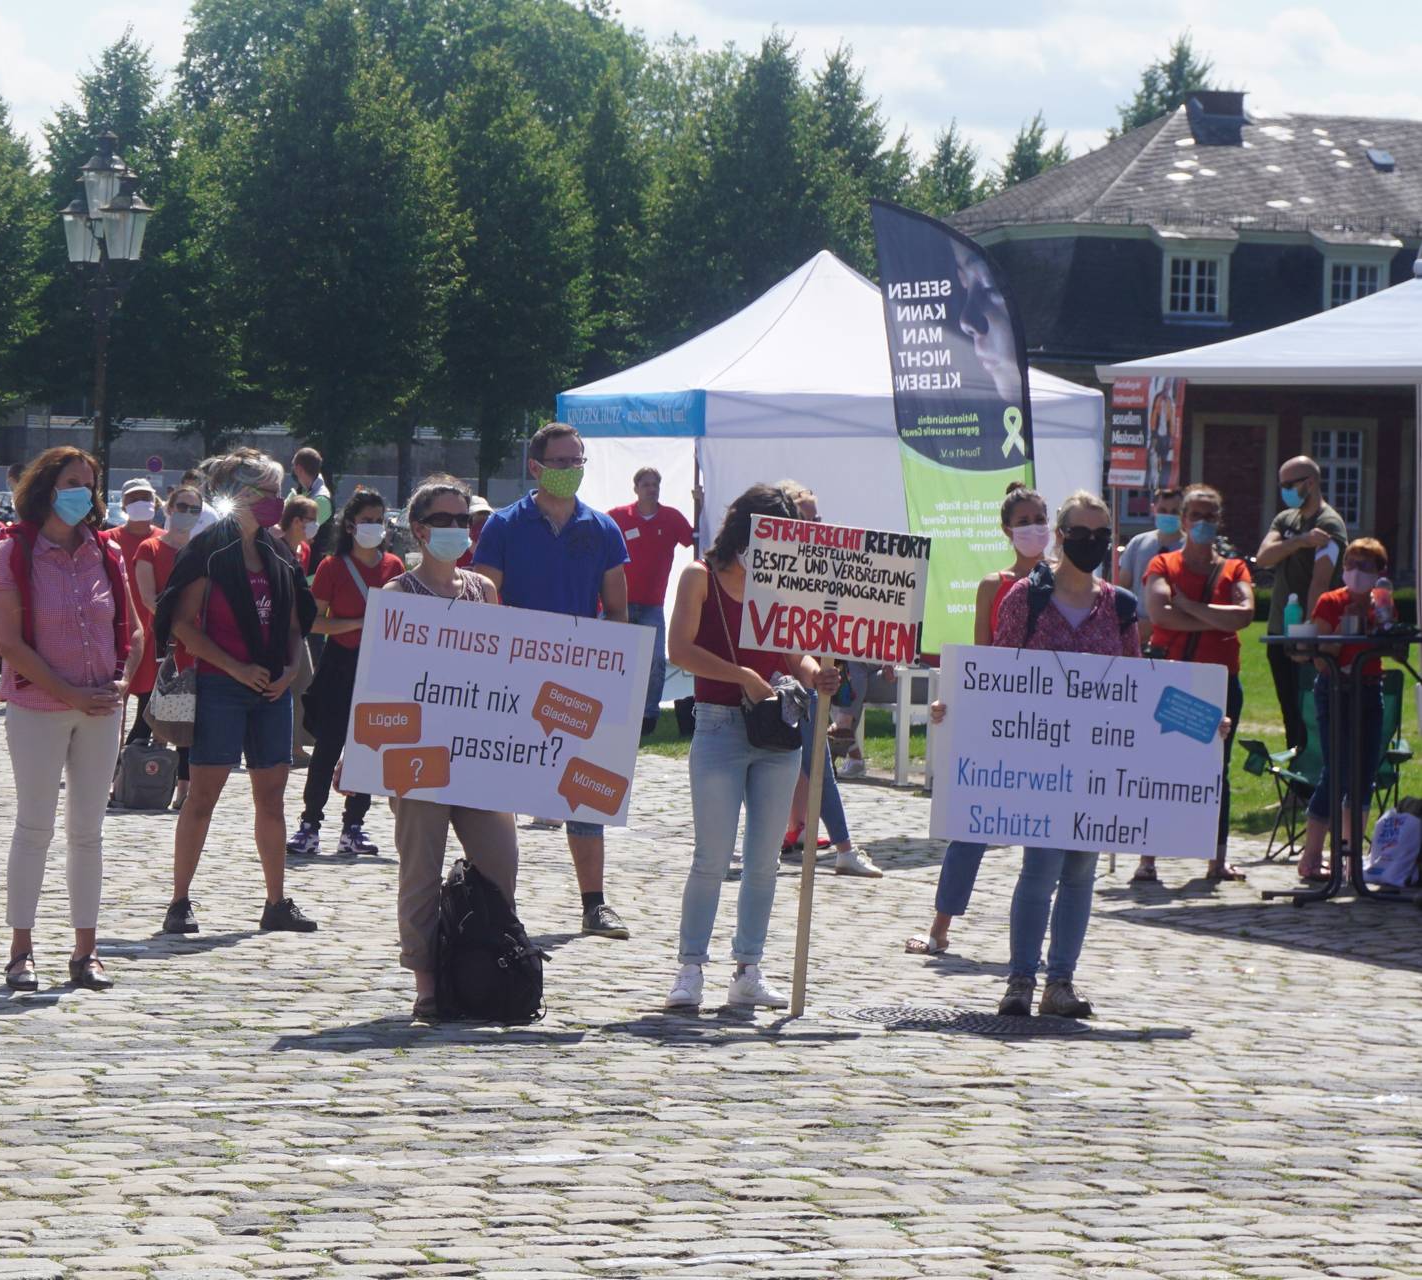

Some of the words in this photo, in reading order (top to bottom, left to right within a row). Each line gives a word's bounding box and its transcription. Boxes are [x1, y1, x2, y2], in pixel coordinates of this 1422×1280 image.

[752, 549, 798, 573] BESITZ
[805, 559, 828, 576] UND
[832, 561, 916, 590] VERBREITUNG
[798, 544, 873, 567] HERSTELLUNG,
[752, 571, 773, 584] VON
[777, 574, 907, 606] KINDERPORNOGRAFIE
[384, 608, 429, 645] Was
[437, 627, 500, 655] muss
[509, 637, 626, 676] passieren,
[748, 599, 923, 665] VERBRECHEN!
[413, 671, 480, 709] damit
[487, 686, 520, 714] nix
[964, 661, 1053, 695] Sexuelle
[1067, 669, 1138, 703] Gewalt
[541, 704, 588, 731] Gladbach
[549, 688, 593, 714] Bergisch
[368, 713, 409, 728] Lügde
[991, 711, 1071, 748] schlägt
[1092, 721, 1135, 748] eine
[450, 735, 563, 767] passiert?
[410, 758, 423, 783] ?
[572, 771, 617, 798] Münster
[957, 757, 1073, 793] Kinderwelt
[1088, 769, 1105, 796] in
[1116, 768, 1220, 804] Trümmer!
[969, 805, 1051, 838] Schützt
[1073, 811, 1148, 845] Kinder!
